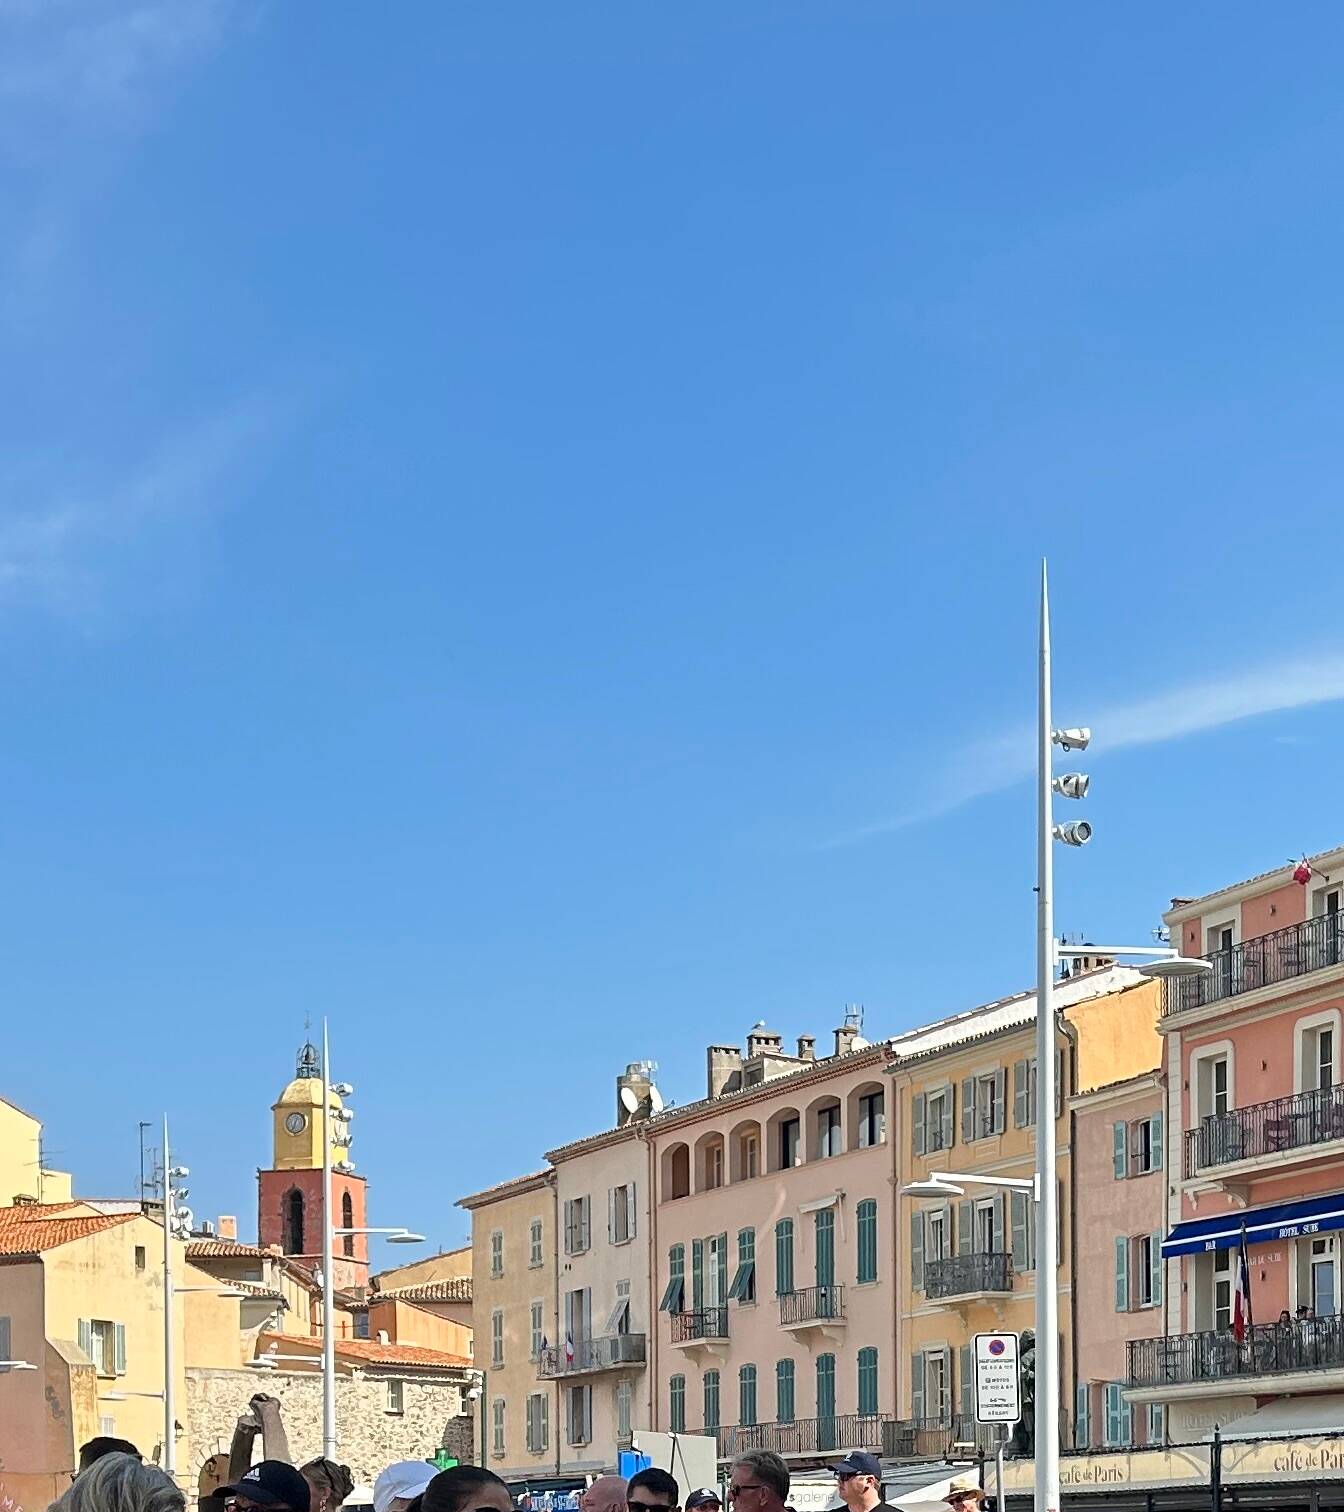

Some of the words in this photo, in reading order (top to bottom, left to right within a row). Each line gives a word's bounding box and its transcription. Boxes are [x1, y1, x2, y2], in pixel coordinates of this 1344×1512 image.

[1274, 1448, 1303, 1472] café
[1305, 1452, 1318, 1467] de
[1059, 1464, 1081, 1485] café
[1082, 1470, 1093, 1481] de
[1094, 1463, 1124, 1483] Paris
